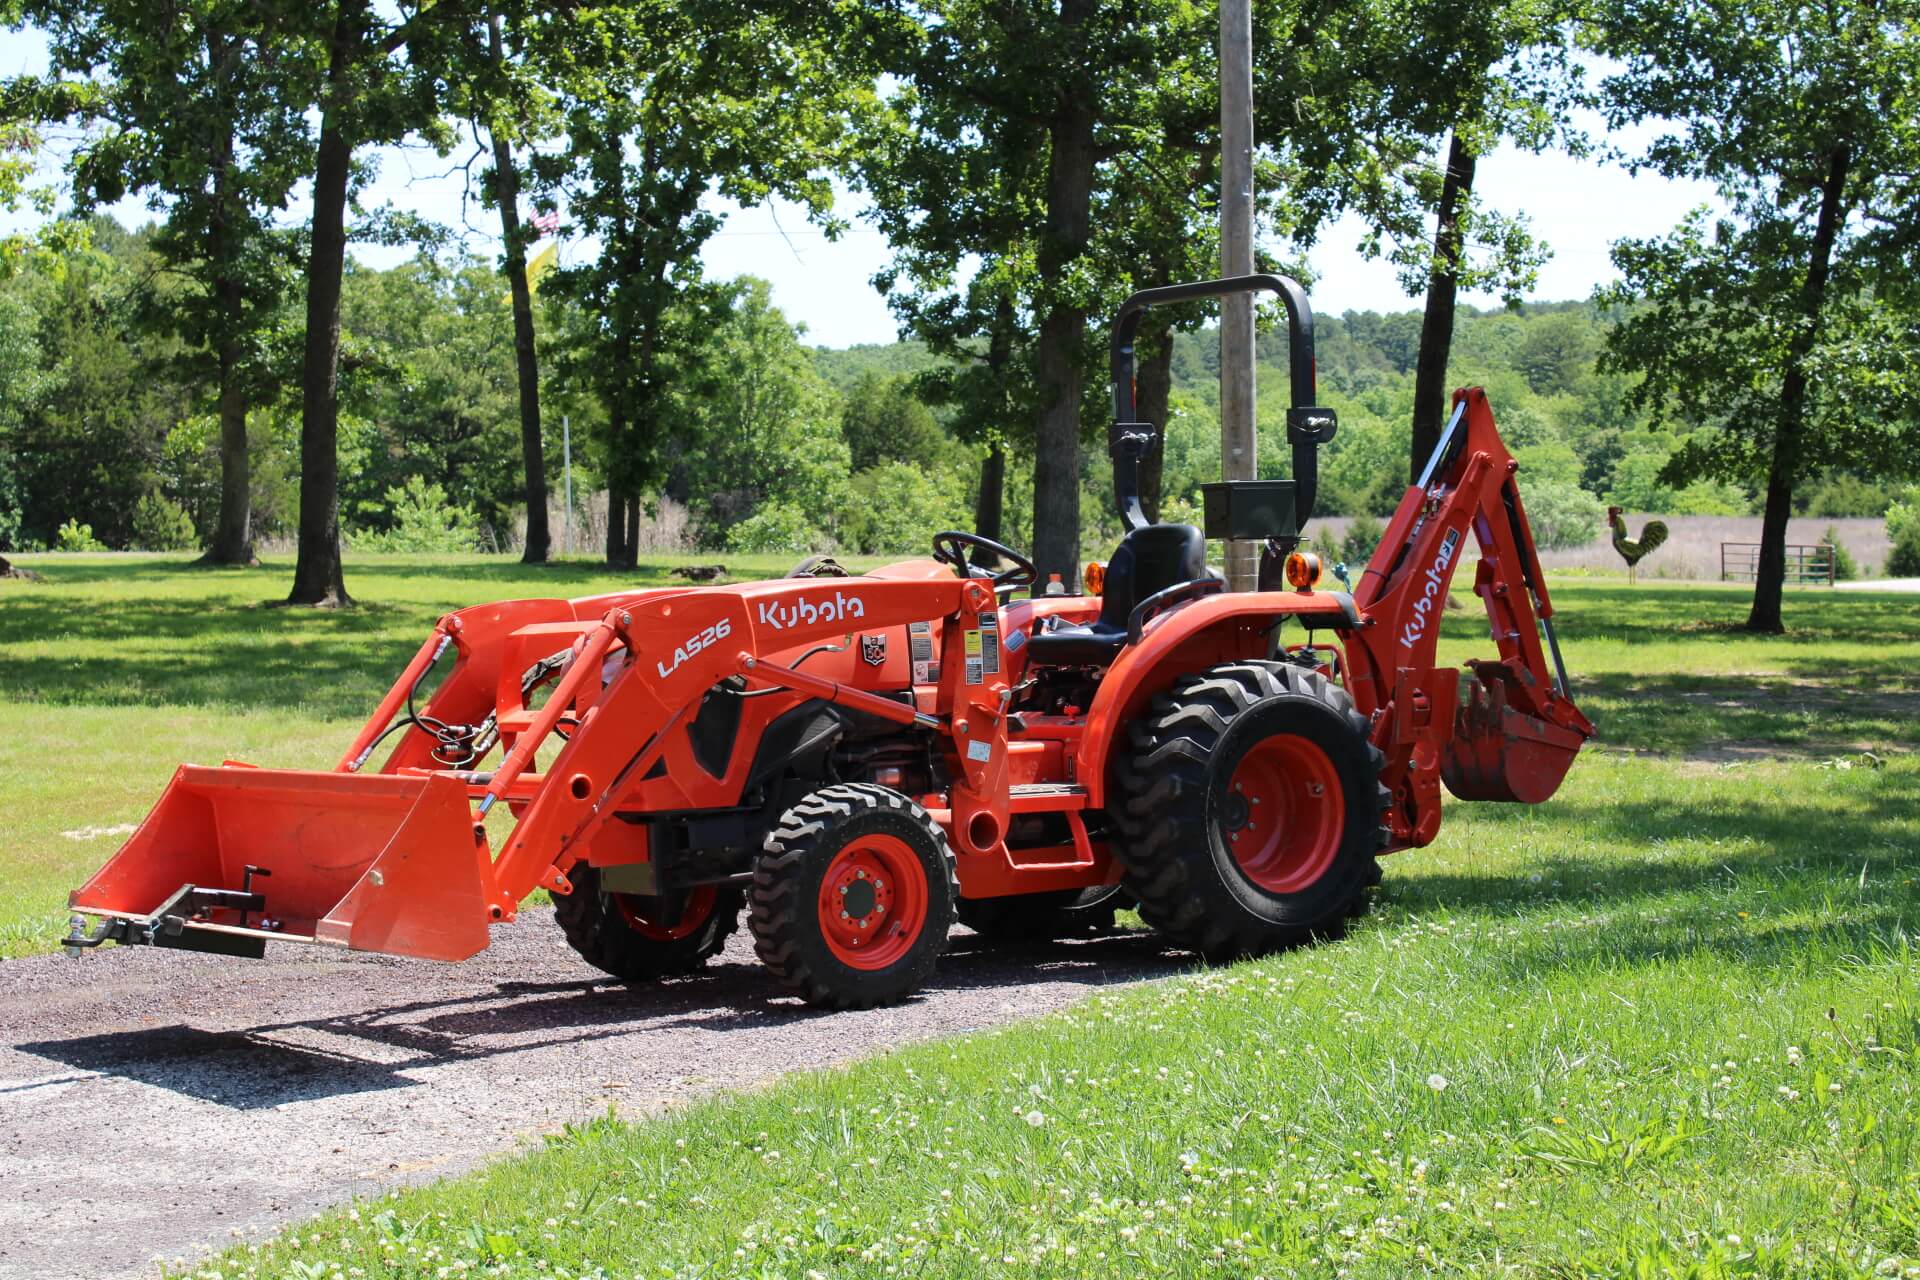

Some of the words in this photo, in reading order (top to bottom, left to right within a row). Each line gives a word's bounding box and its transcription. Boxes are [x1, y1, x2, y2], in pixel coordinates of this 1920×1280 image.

[758, 591, 864, 629] Kubota
[1400, 555, 1448, 648] Kubota
[656, 617, 732, 678] LA526
